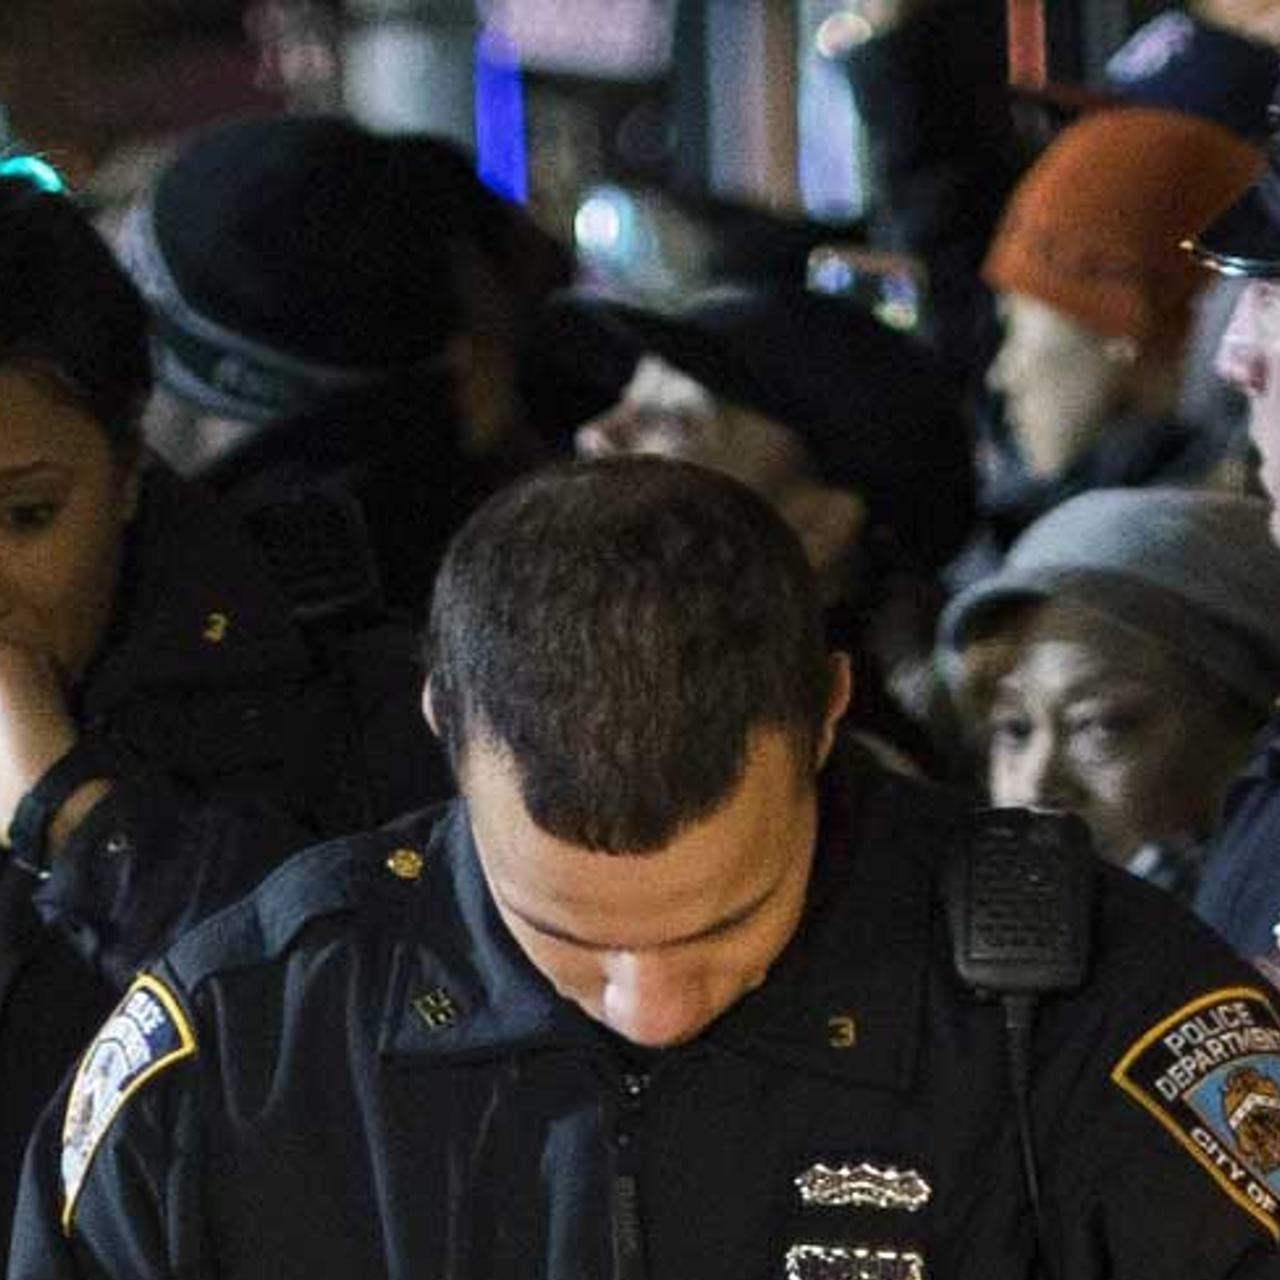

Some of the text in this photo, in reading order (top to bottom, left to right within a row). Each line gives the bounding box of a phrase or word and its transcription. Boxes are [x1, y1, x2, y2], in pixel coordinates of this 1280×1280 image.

[1163, 1001, 1254, 1058] POLICE
[1190, 1127, 1247, 1182] CITY
[1247, 1181, 1278, 1213] OF
